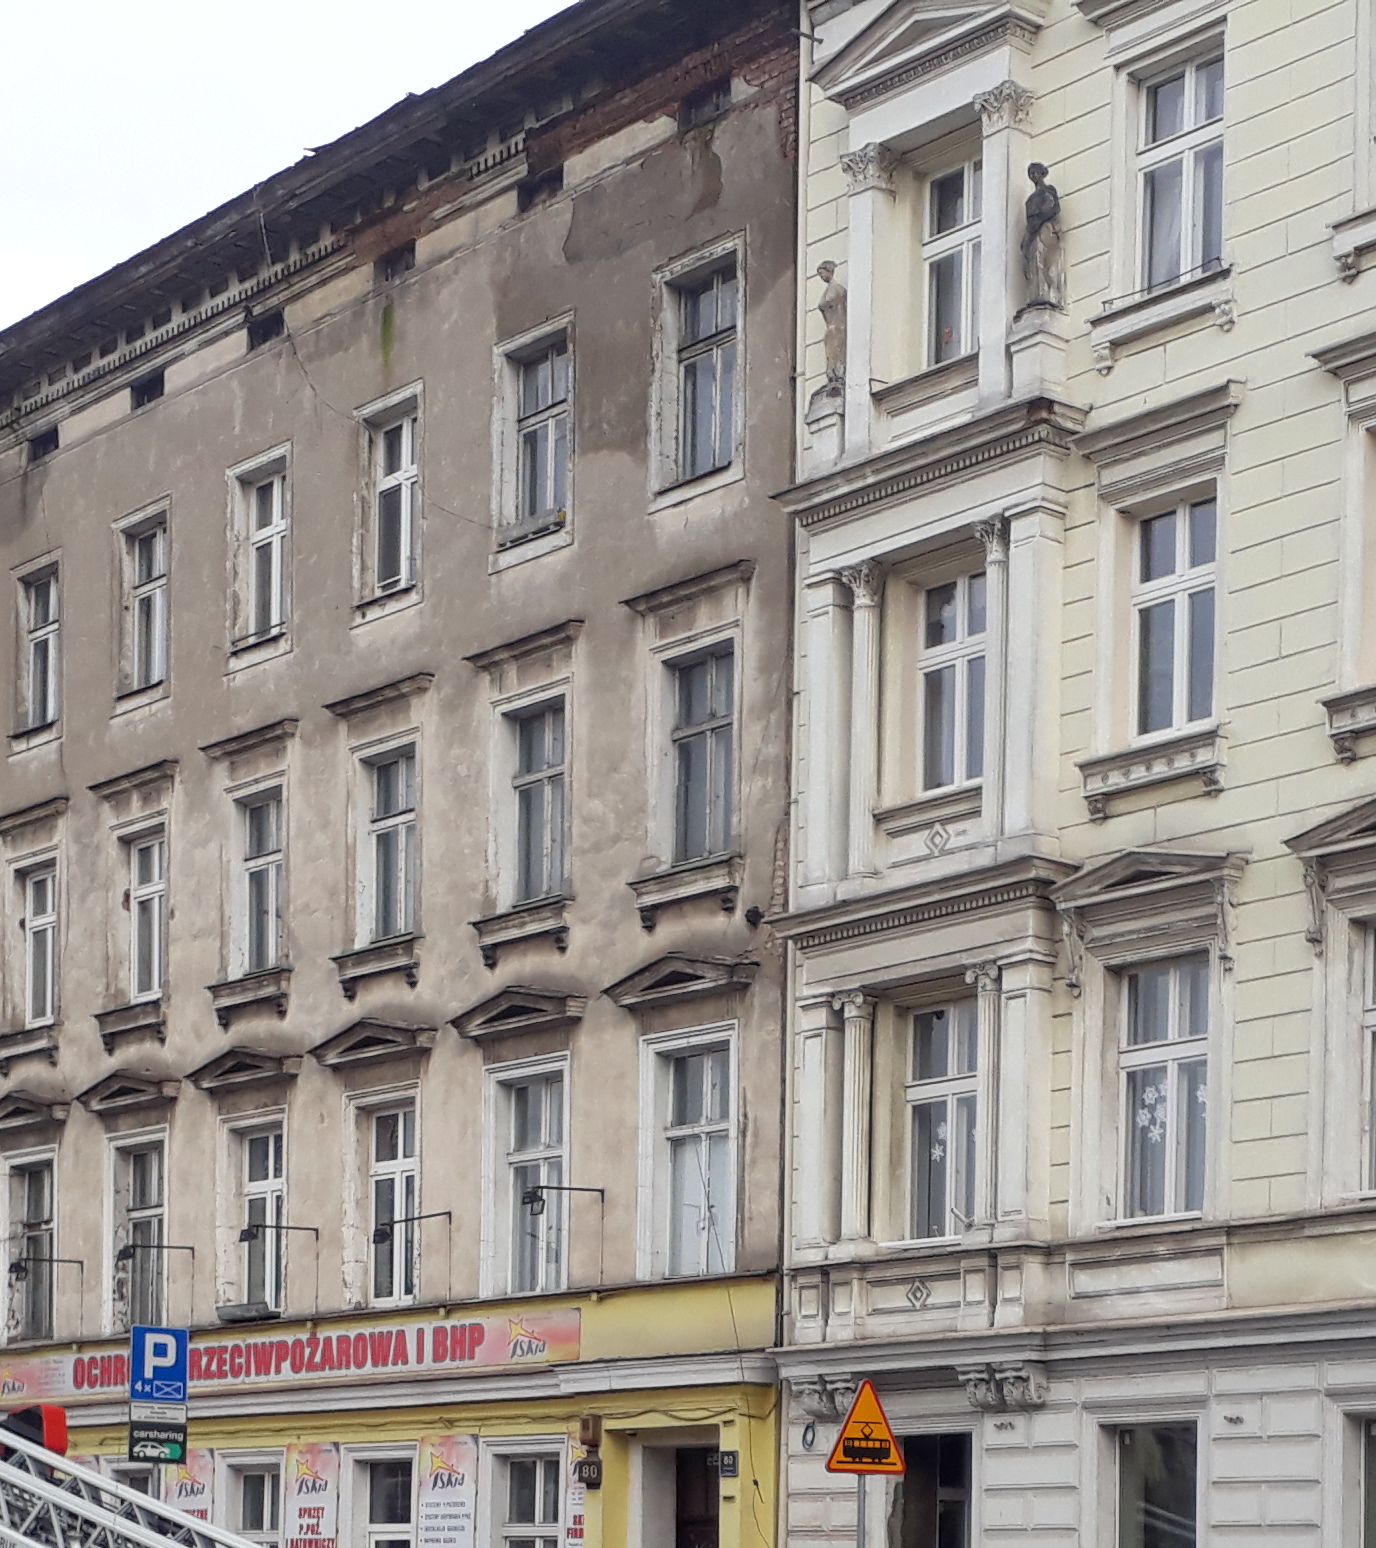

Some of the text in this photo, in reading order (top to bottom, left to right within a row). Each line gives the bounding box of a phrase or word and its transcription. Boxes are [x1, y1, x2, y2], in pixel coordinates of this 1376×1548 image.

[144, 1332, 177, 1380] P
[188, 1329, 409, 1381] RZECIWPOŻAROWA
[416, 1327, 425, 1365] I
[431, 1322, 486, 1363] BHP
[132, 1430, 184, 1442] carsharing
[582, 1464, 598, 1479] 80
